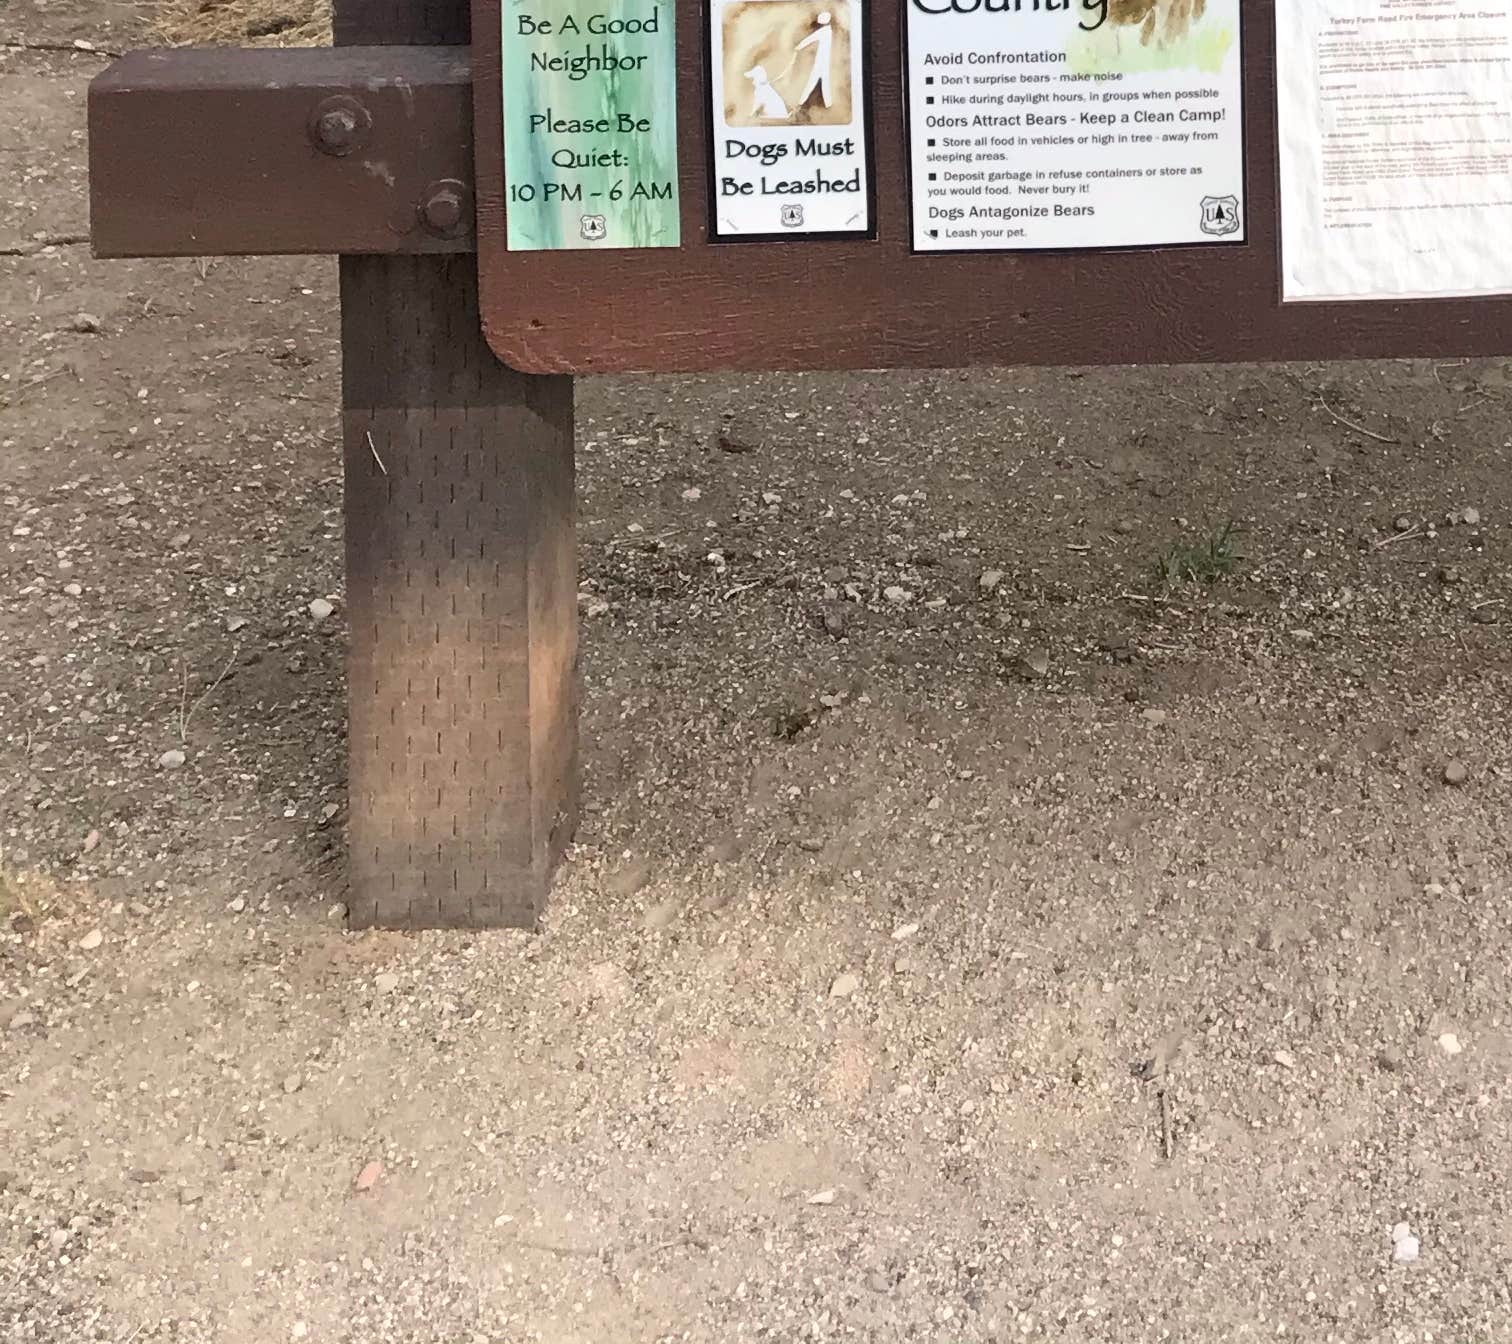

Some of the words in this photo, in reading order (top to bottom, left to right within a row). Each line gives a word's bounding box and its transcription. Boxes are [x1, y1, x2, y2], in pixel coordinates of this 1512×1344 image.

[518, 16, 551, 35] Be
[559, 15, 580, 34] A
[587, 7, 658, 34] Good
[531, 46, 648, 80] Neighbor
[924, 53, 963, 65] Avoid
[968, 51, 1066, 64] Confrontation
[941, 76, 970, 85] Don't
[974, 75, 1016, 85] surprise
[1020, 73, 1050, 83] bears
[1060, 73, 1090, 82] make
[1094, 72, 1123, 81] noise
[530, 108, 609, 133] Please
[617, 115, 650, 132] Be
[926, 115, 967, 128] Odors
[972, 114, 1020, 127] Attract
[1026, 113, 1067, 125] Bears
[1080, 112, 1115, 125] Keep
[1121, 115, 1129, 123] a
[1134, 111, 1174, 123] Clean
[1179, 109, 1226, 123] Camp!
[551, 150, 628, 168] Quiet:
[726, 140, 788, 165] Dogs
[795, 138, 855, 156] Must
[511, 184, 534, 202] 10
[543, 184, 582, 202] PM
[609, 180, 622, 201] 6
[632, 182, 673, 200] AM
[722, 178, 753, 195] Be
[762, 169, 860, 194] Leashed
[929, 207, 964, 220] Dogs
[969, 206, 1049, 219] Antagonize
[1054, 204, 1095, 217] Bears
